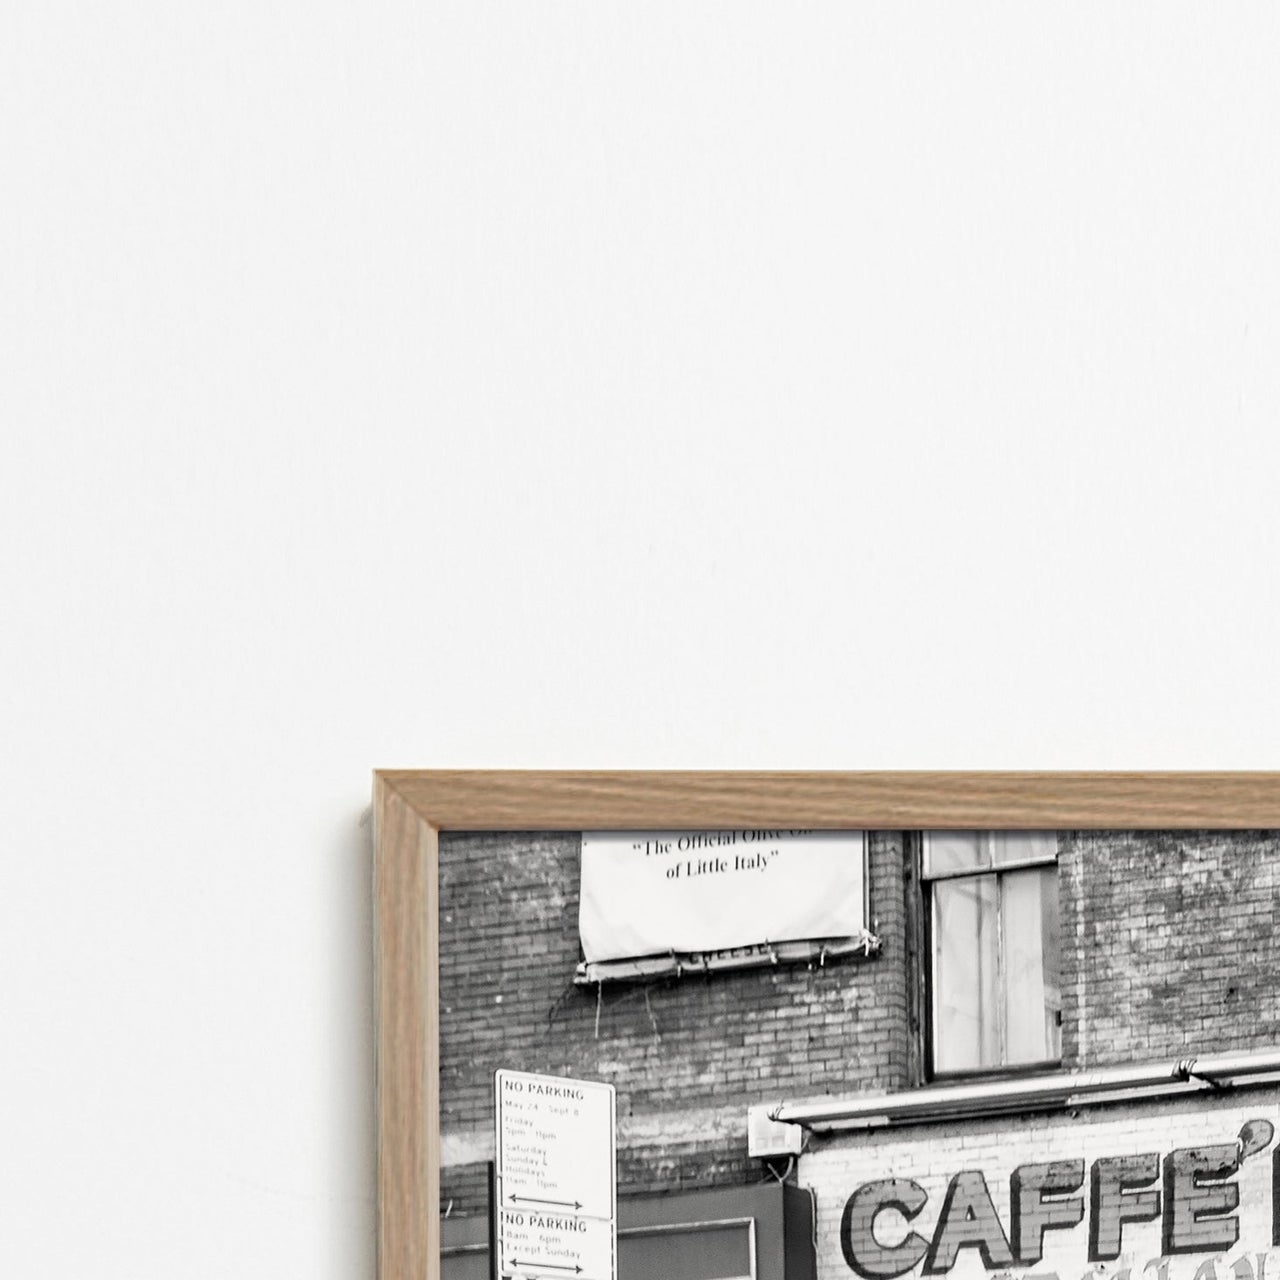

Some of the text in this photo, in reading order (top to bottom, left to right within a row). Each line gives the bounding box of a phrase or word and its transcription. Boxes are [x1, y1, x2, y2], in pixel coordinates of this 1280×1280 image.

[677, 829, 736, 852] Official
[666, 863, 682, 879] of
[686, 857, 729, 877] Little
[504, 1080, 584, 1101] NO PARKING
[504, 1100, 524, 1110] May
[504, 1116, 534, 1128] Friday
[505, 1143, 548, 1157] Saturday
[505, 1154, 539, 1167] Sunday
[505, 1165, 545, 1177] Holidays
[505, 1213, 587, 1233] NO PARKING
[506, 1230, 529, 1241] 8am
[506, 1242, 581, 1261] Except Sunday
